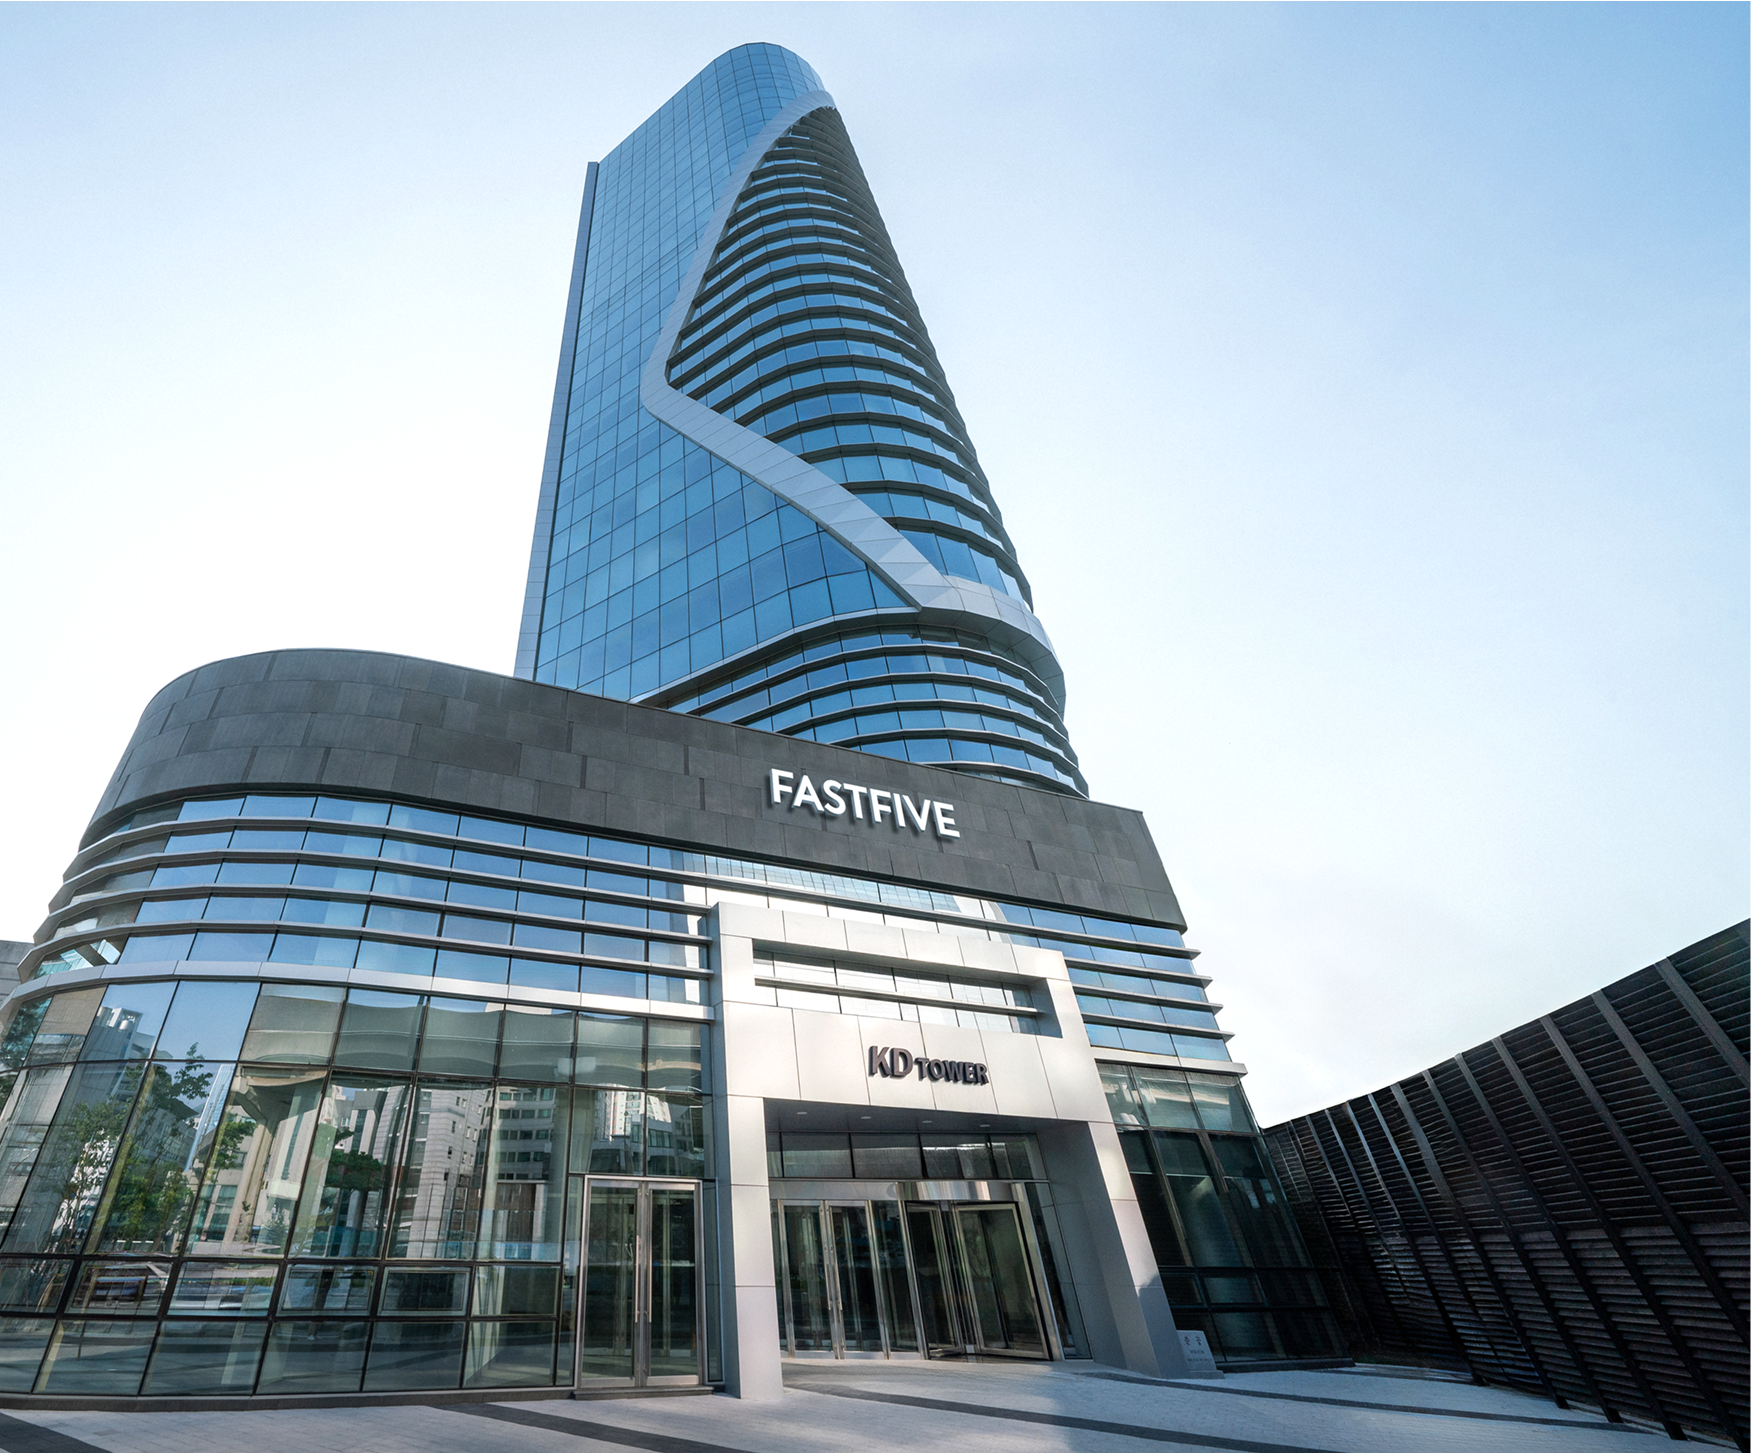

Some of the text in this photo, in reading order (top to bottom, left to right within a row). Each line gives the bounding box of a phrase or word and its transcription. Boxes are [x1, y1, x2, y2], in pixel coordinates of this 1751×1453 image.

[769, 767, 961, 839] FASTFIVE
[867, 1044, 990, 1086] KD TOWER
